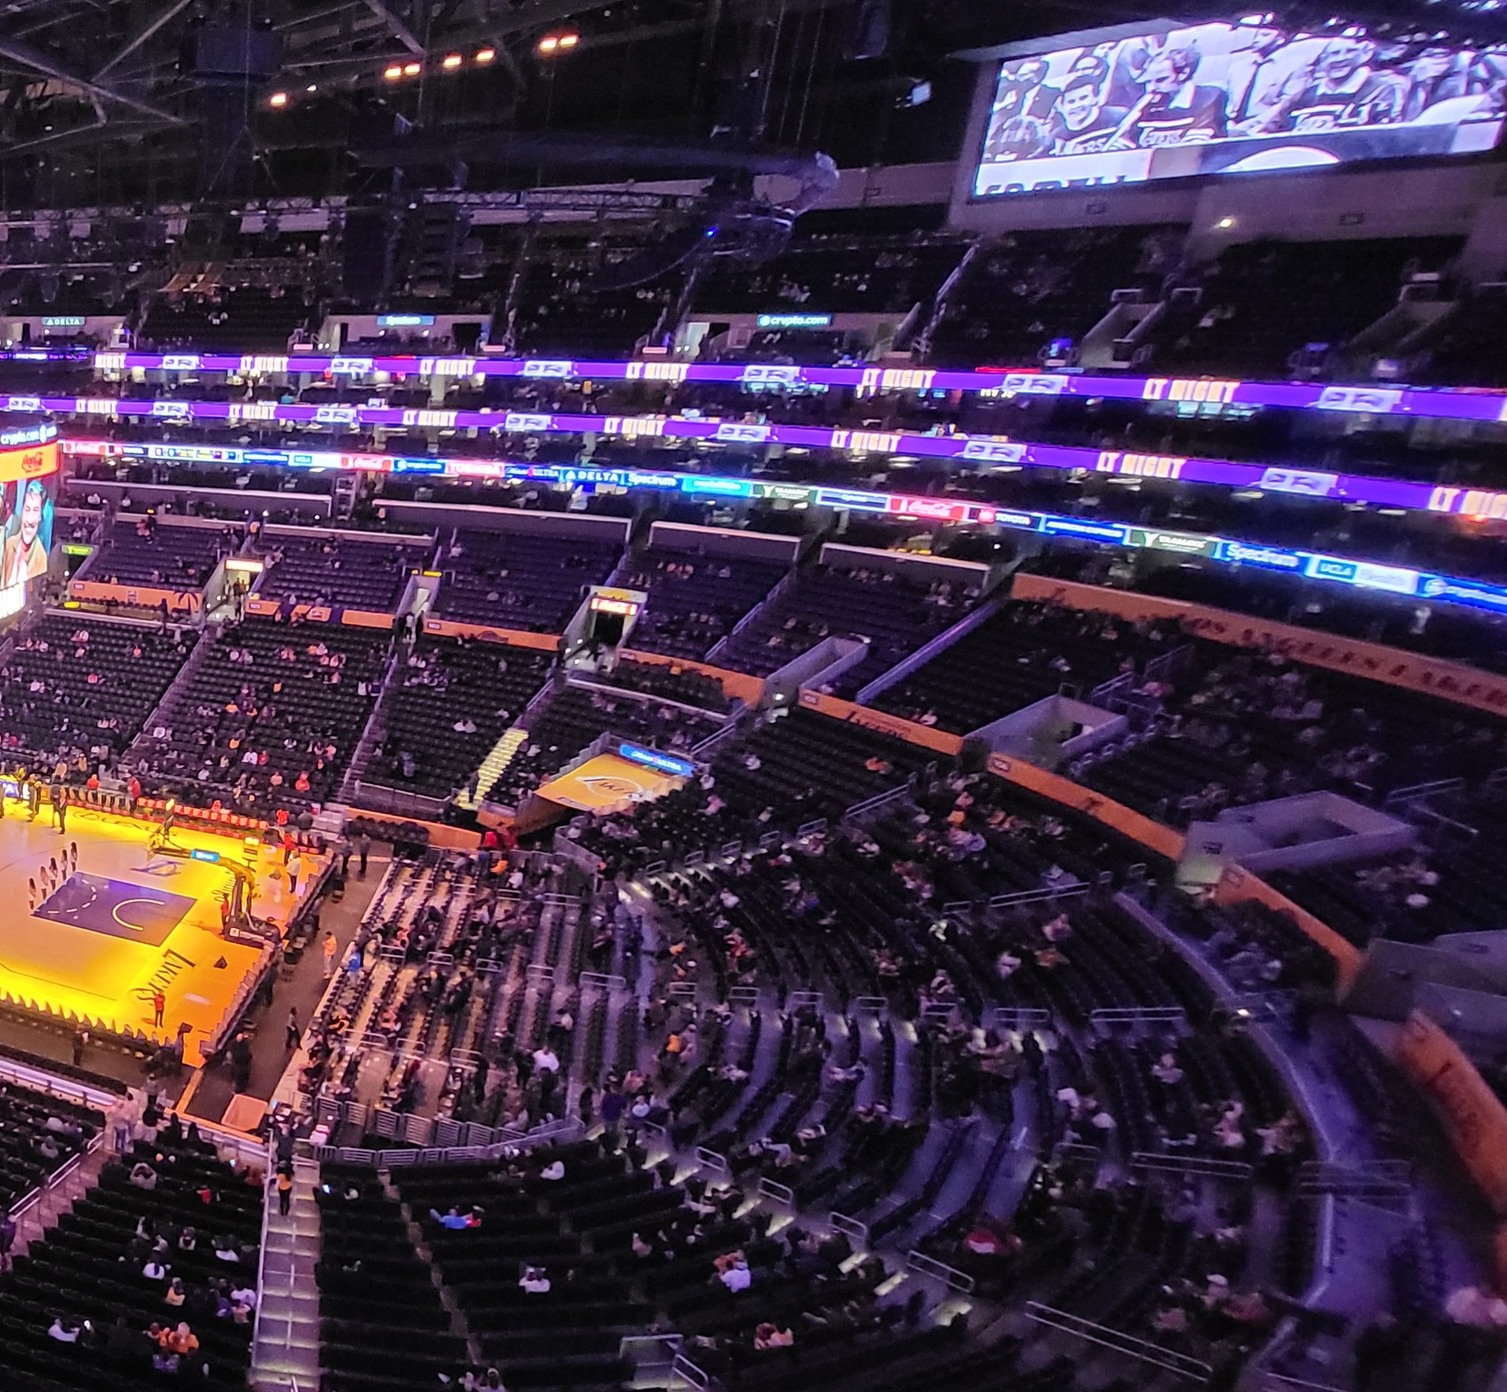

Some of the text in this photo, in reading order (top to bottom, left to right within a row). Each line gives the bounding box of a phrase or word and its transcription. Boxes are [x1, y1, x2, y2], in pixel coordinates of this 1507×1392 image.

[56, 317, 82, 326] DELTA
[770, 315, 829, 327] crypto.com
[0, 431, 40, 446] crypto.com
[578, 471, 619, 483] DELTA
[628, 472, 676, 487] Spectrum
[1227, 543, 1299, 567] Spectrum
[1321, 562, 1352, 577] UCLA
